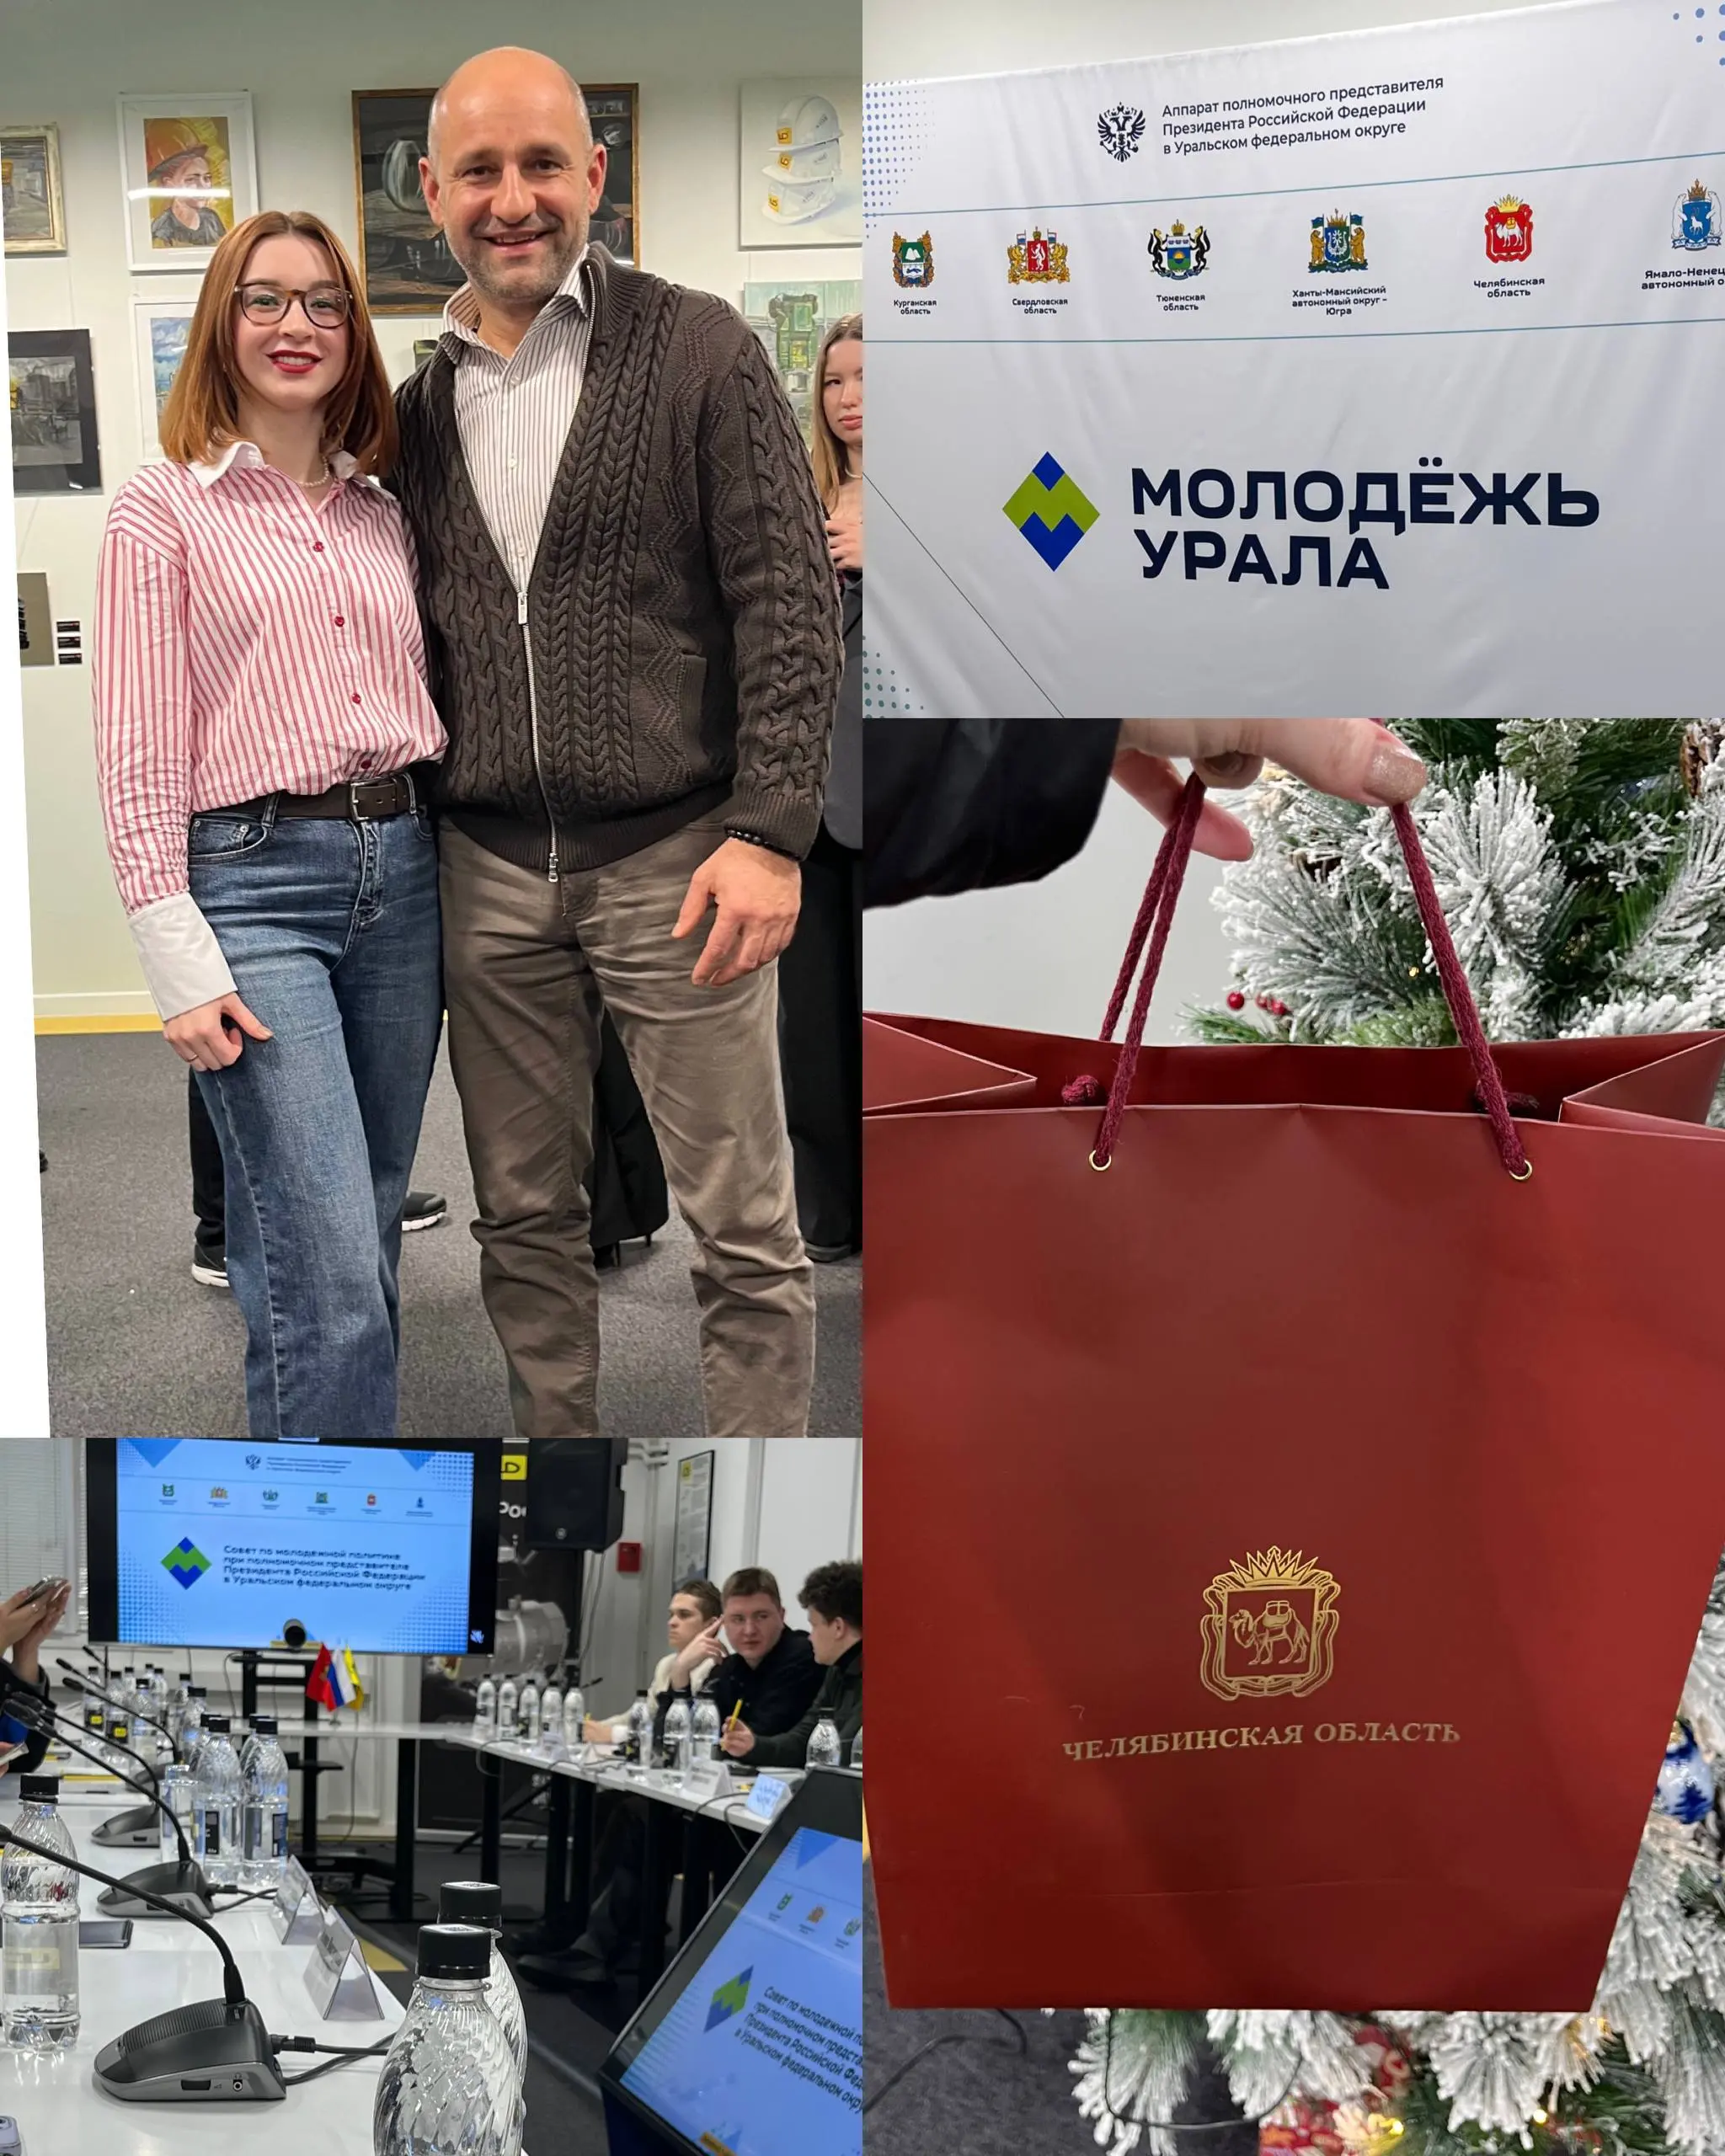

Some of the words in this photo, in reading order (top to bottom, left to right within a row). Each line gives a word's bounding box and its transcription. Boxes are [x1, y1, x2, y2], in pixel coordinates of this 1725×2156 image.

[1162, 102, 1219, 117] Аппарат
[1223, 91, 1326, 111] полномочного
[1329, 77, 1444, 102] представителя
[1163, 119, 1245, 137] Президента
[1249, 106, 1333, 128] Российской
[1338, 100, 1426, 119] Федерации
[1163, 145, 1171, 154] в
[1174, 137, 1247, 156] Уральском
[1251, 128, 1350, 149] федеральном
[1354, 122, 1406, 139] округе
[1645, 267, 1725, 279] Ямало-Ненец
[1474, 277, 1545, 288] Челябинская
[1641, 277, 1715, 290] автономный
[1156, 294, 1206, 302] Тюменская
[1292, 286, 1386, 297] Ханты-Мансийский
[1487, 288, 1531, 297] область
[894, 299, 937, 307] Курганская
[1012, 298, 1068, 307] Свердловская
[1163, 302, 1199, 312] область
[1292, 296, 1351, 307] автономный
[1353, 296, 1381, 306] округ
[1326, 307, 1352, 317] Югра
[1130, 456, 1599, 536] МОЛОДЁЖЬ
[1133, 529, 1390, 590] УРАЛА
[224, 1545, 257, 1555] Совет
[224, 1557, 244, 1566] при
[224, 1566, 291, 1576] Президента
[294, 1567, 360, 1577] Российской
[362, 1571, 426, 1581] Федерации
[233, 1576, 294, 1587] Уральском
[296, 1577, 372, 1589] федеральном
[1062, 1724, 1304, 1761] ЧЕЛЯБИНСКАЯ
[1314, 1722, 1461, 1742] ОБЛАСТЬ
[764, 1986, 789, 2004] Совет
[787, 1999, 799, 2011] по
[798, 2005, 856, 2040] молодежной
[770, 2009, 826, 2046] полномочном
[790, 2038, 845, 2076] Российской
[780, 2052, 844, 2097] федеральном
